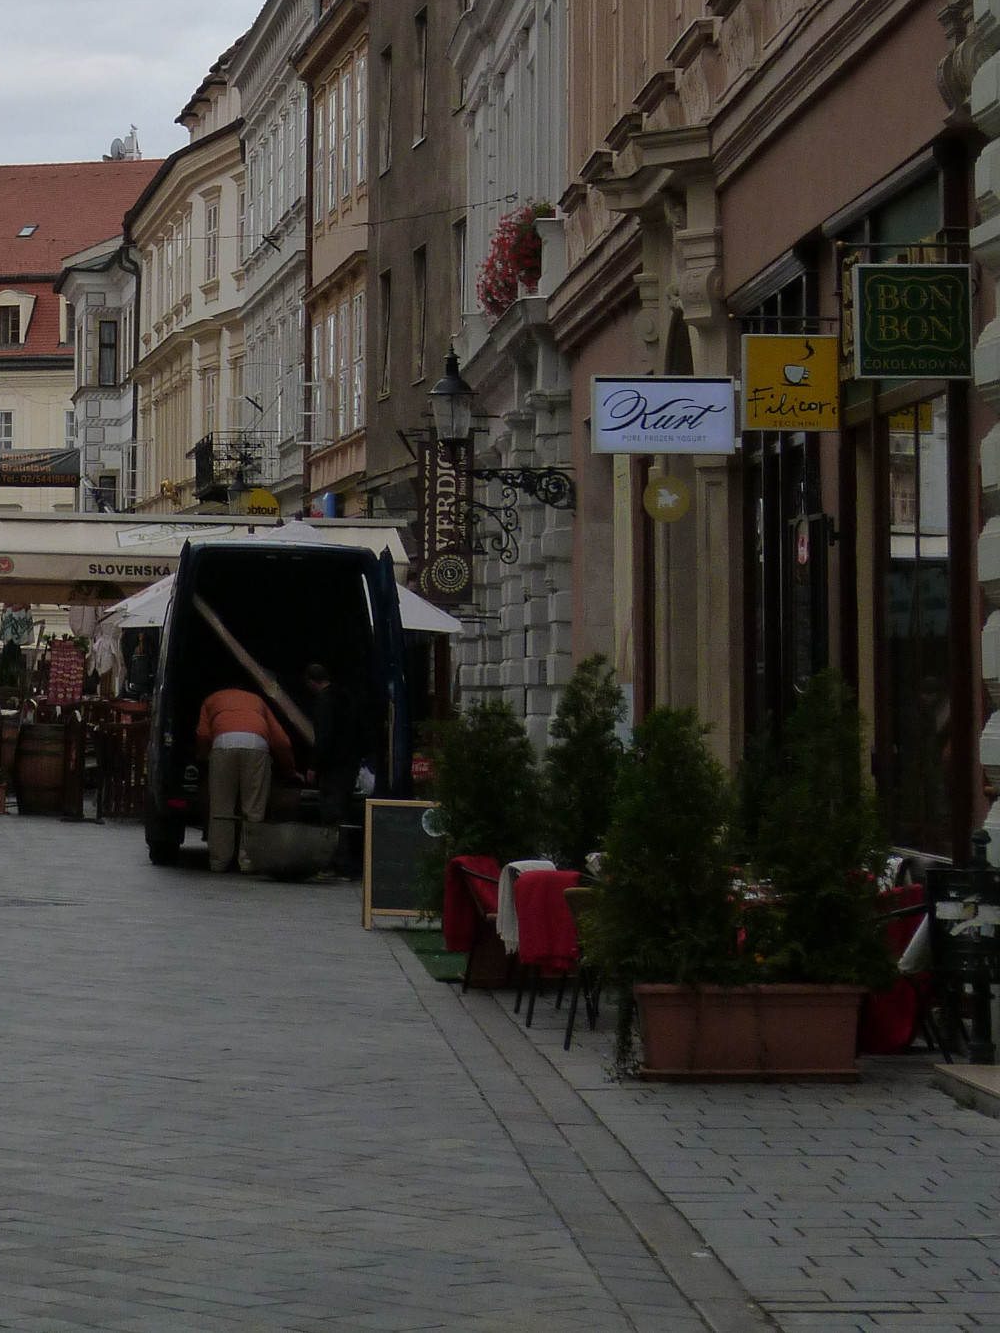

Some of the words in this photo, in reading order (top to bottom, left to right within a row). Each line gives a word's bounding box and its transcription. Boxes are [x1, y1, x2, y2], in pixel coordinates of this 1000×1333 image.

[876, 284, 954, 310] BON
[876, 314, 954, 341] BON
[864, 356, 968, 369] ČOKOLÁDOVŇA
[601, 389, 727, 431] Kurt
[747, 386, 839, 418] Filicori
[621, 434, 642, 442] PURE
[644, 434, 674, 442] FROZEN
[676, 434, 706, 442] YOGURT
[2, 463, 51, 472] Bratislava
[435, 439, 457, 552] VERDIC
[246, 505, 277, 515] obtour
[89, 563, 171, 576] SLOVENSKÁ
